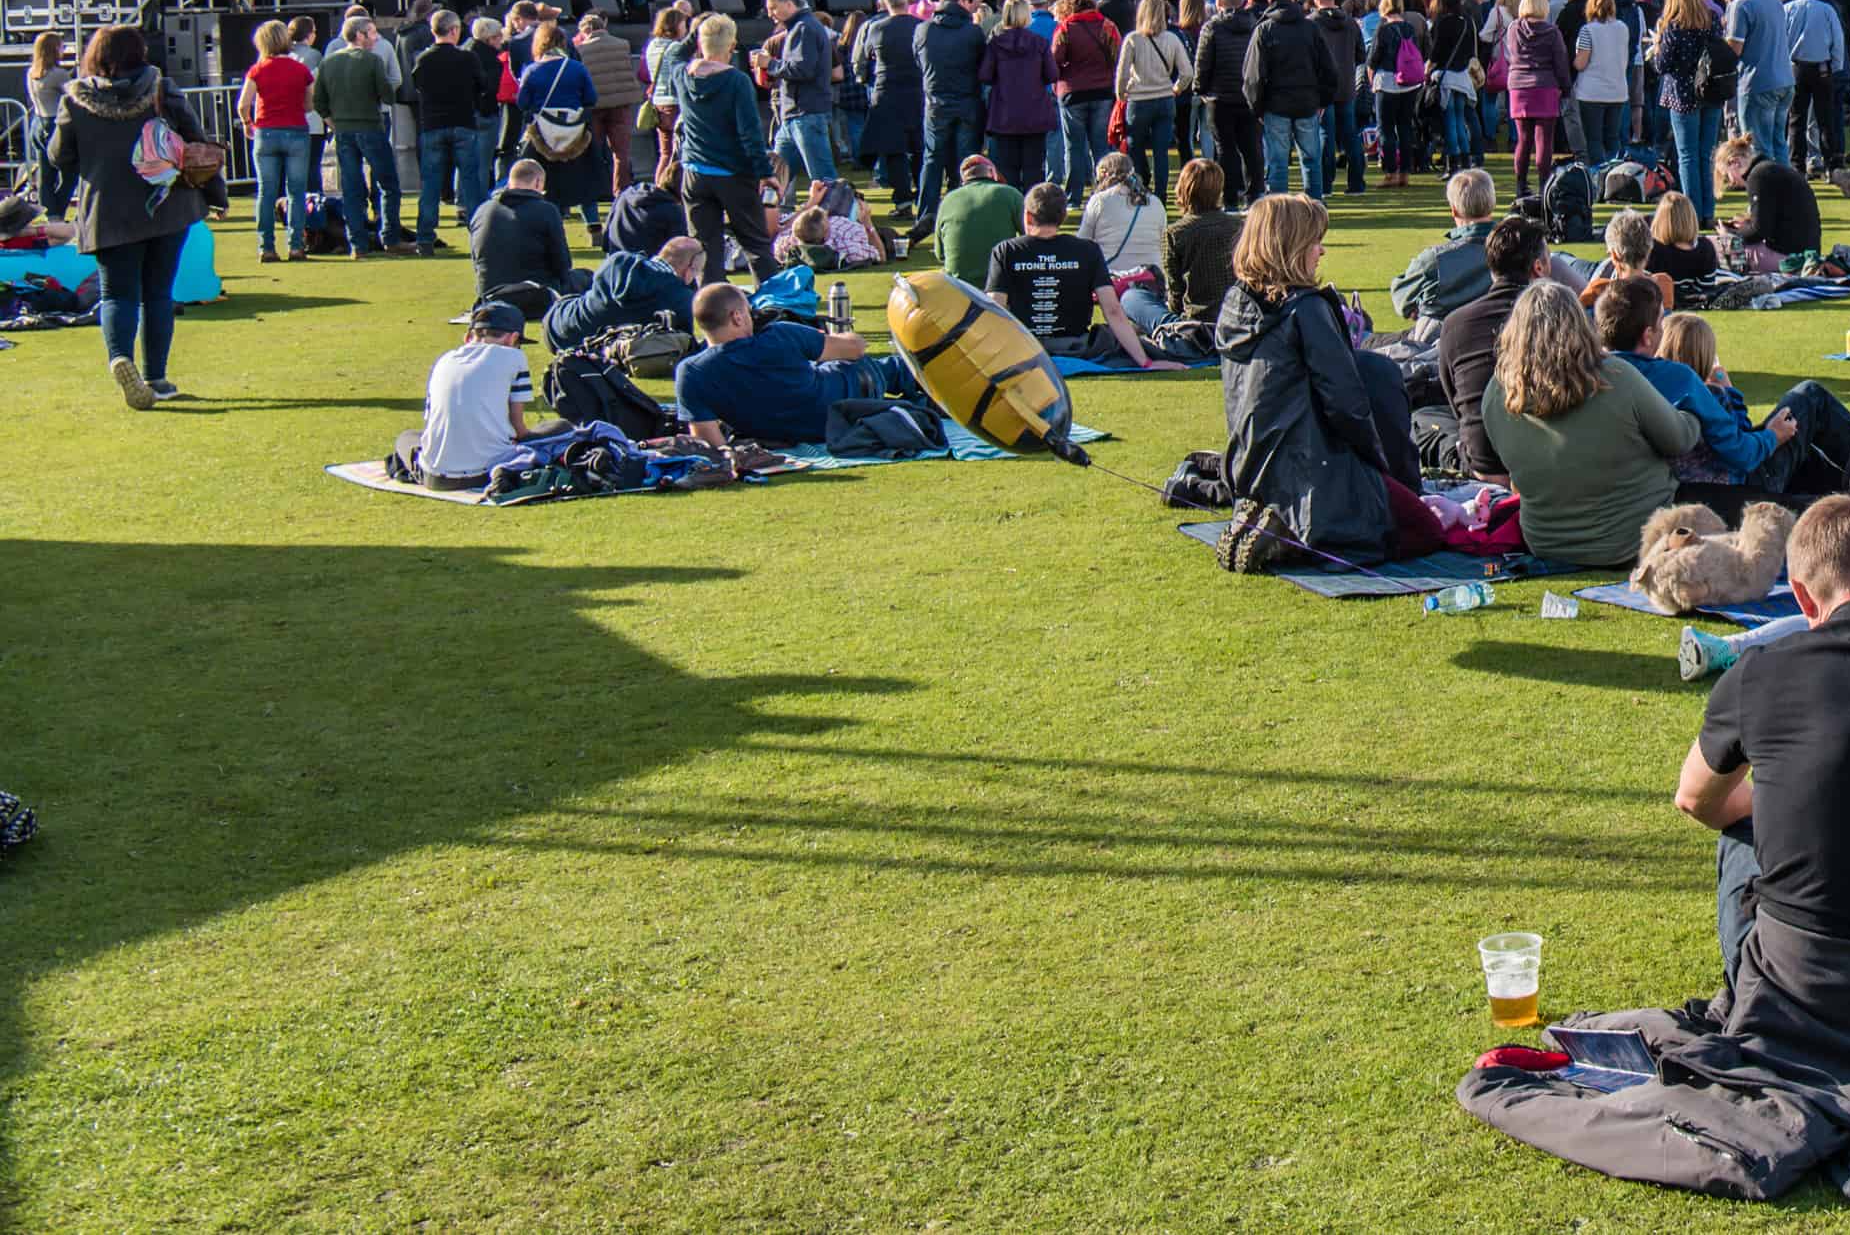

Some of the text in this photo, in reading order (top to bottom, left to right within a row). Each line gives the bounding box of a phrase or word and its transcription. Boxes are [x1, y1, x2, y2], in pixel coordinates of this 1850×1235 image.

[1038, 254, 1057, 263] THE
[1014, 261, 1079, 271] STONE ROSES
